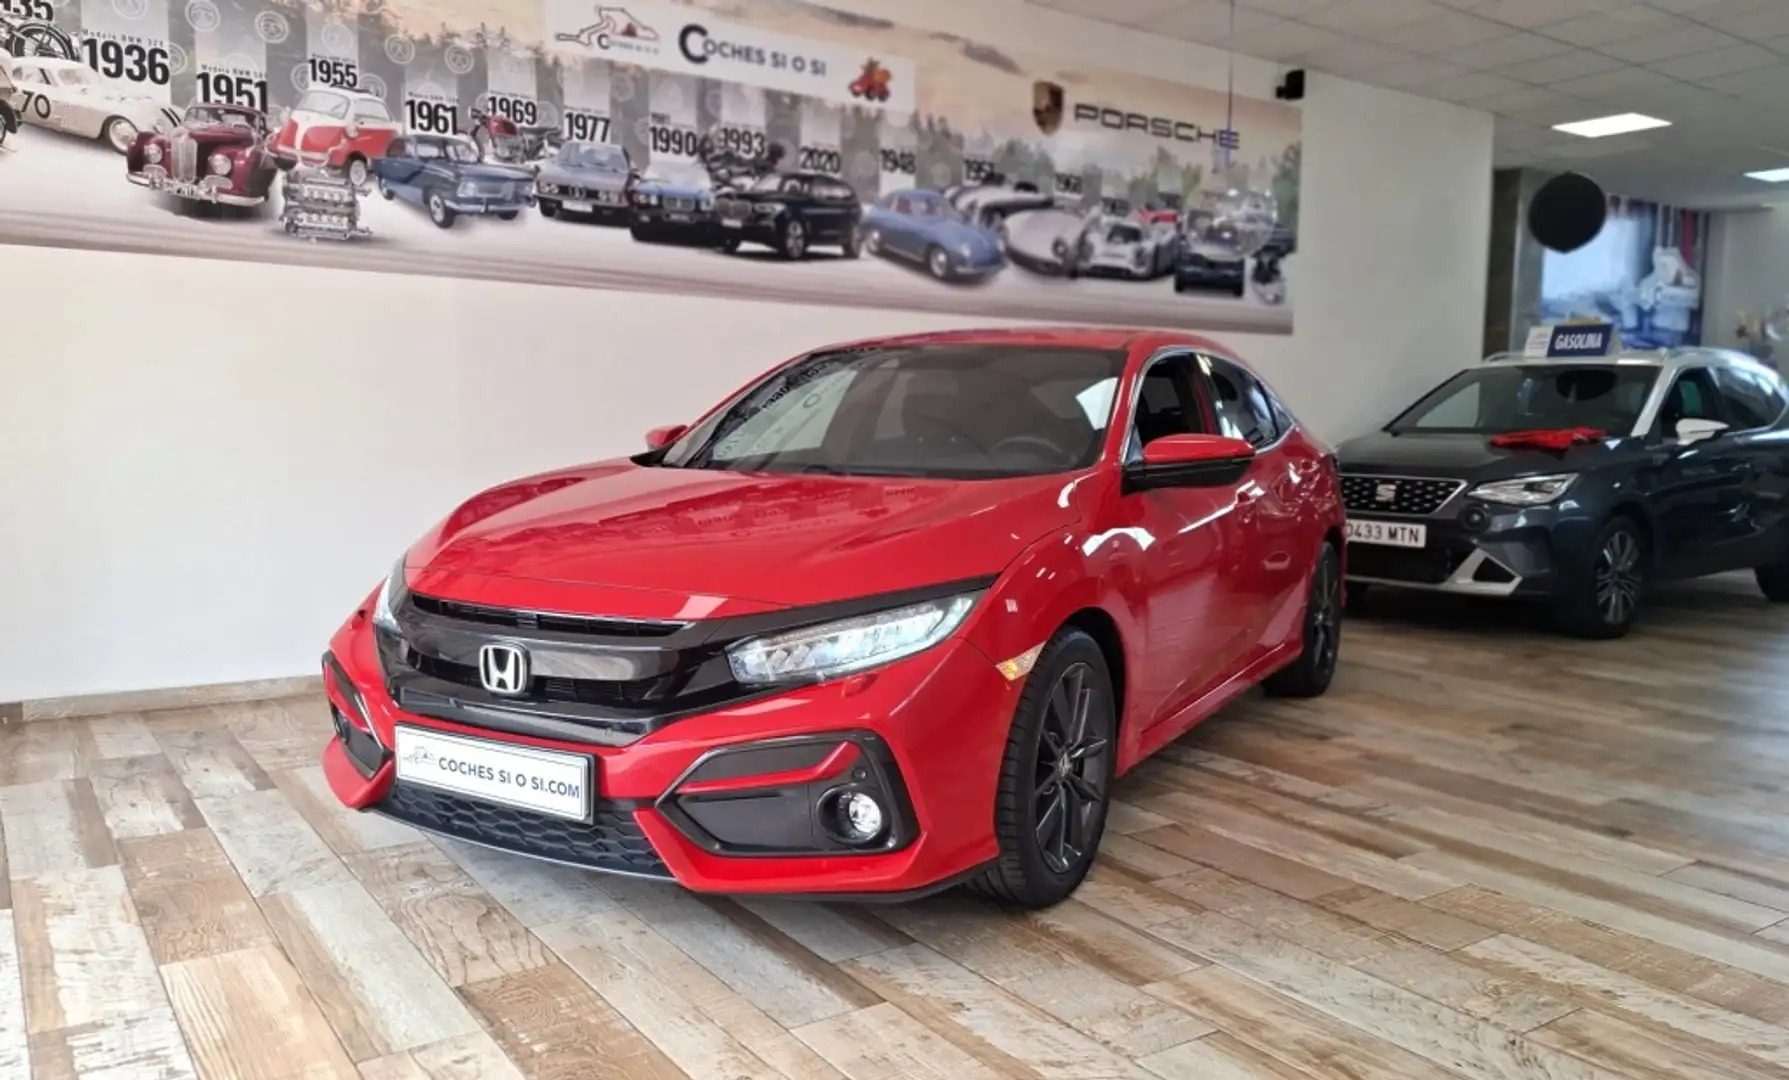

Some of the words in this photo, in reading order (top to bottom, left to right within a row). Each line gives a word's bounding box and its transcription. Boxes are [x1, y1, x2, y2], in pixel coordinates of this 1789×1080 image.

[82, 38, 170, 85] 1936
[678, 23, 766, 65] COCHES
[771, 51, 787, 69] SI
[792, 55, 806, 73] O
[810, 59, 826, 76] SI
[309, 58, 358, 87] 1955
[20, 90, 51, 119] 70
[196, 72, 268, 114] 1951
[405, 99, 458, 135] 1961
[488, 95, 538, 126] 1969
[564, 111, 611, 143] 1977
[649, 127, 698, 157] 1990
[721, 127, 765, 157] 1993
[1074, 103, 1240, 150] PORSCHE
[801, 145, 841, 173] 2020
[1555, 332, 1603, 352] GASOLINA
[1388, 525, 1419, 544] MTN
[438, 757, 494, 781] COCHES
[499, 770, 511, 784] SI
[515, 773, 527, 787] O
[531, 776, 580, 799] SI.COM
